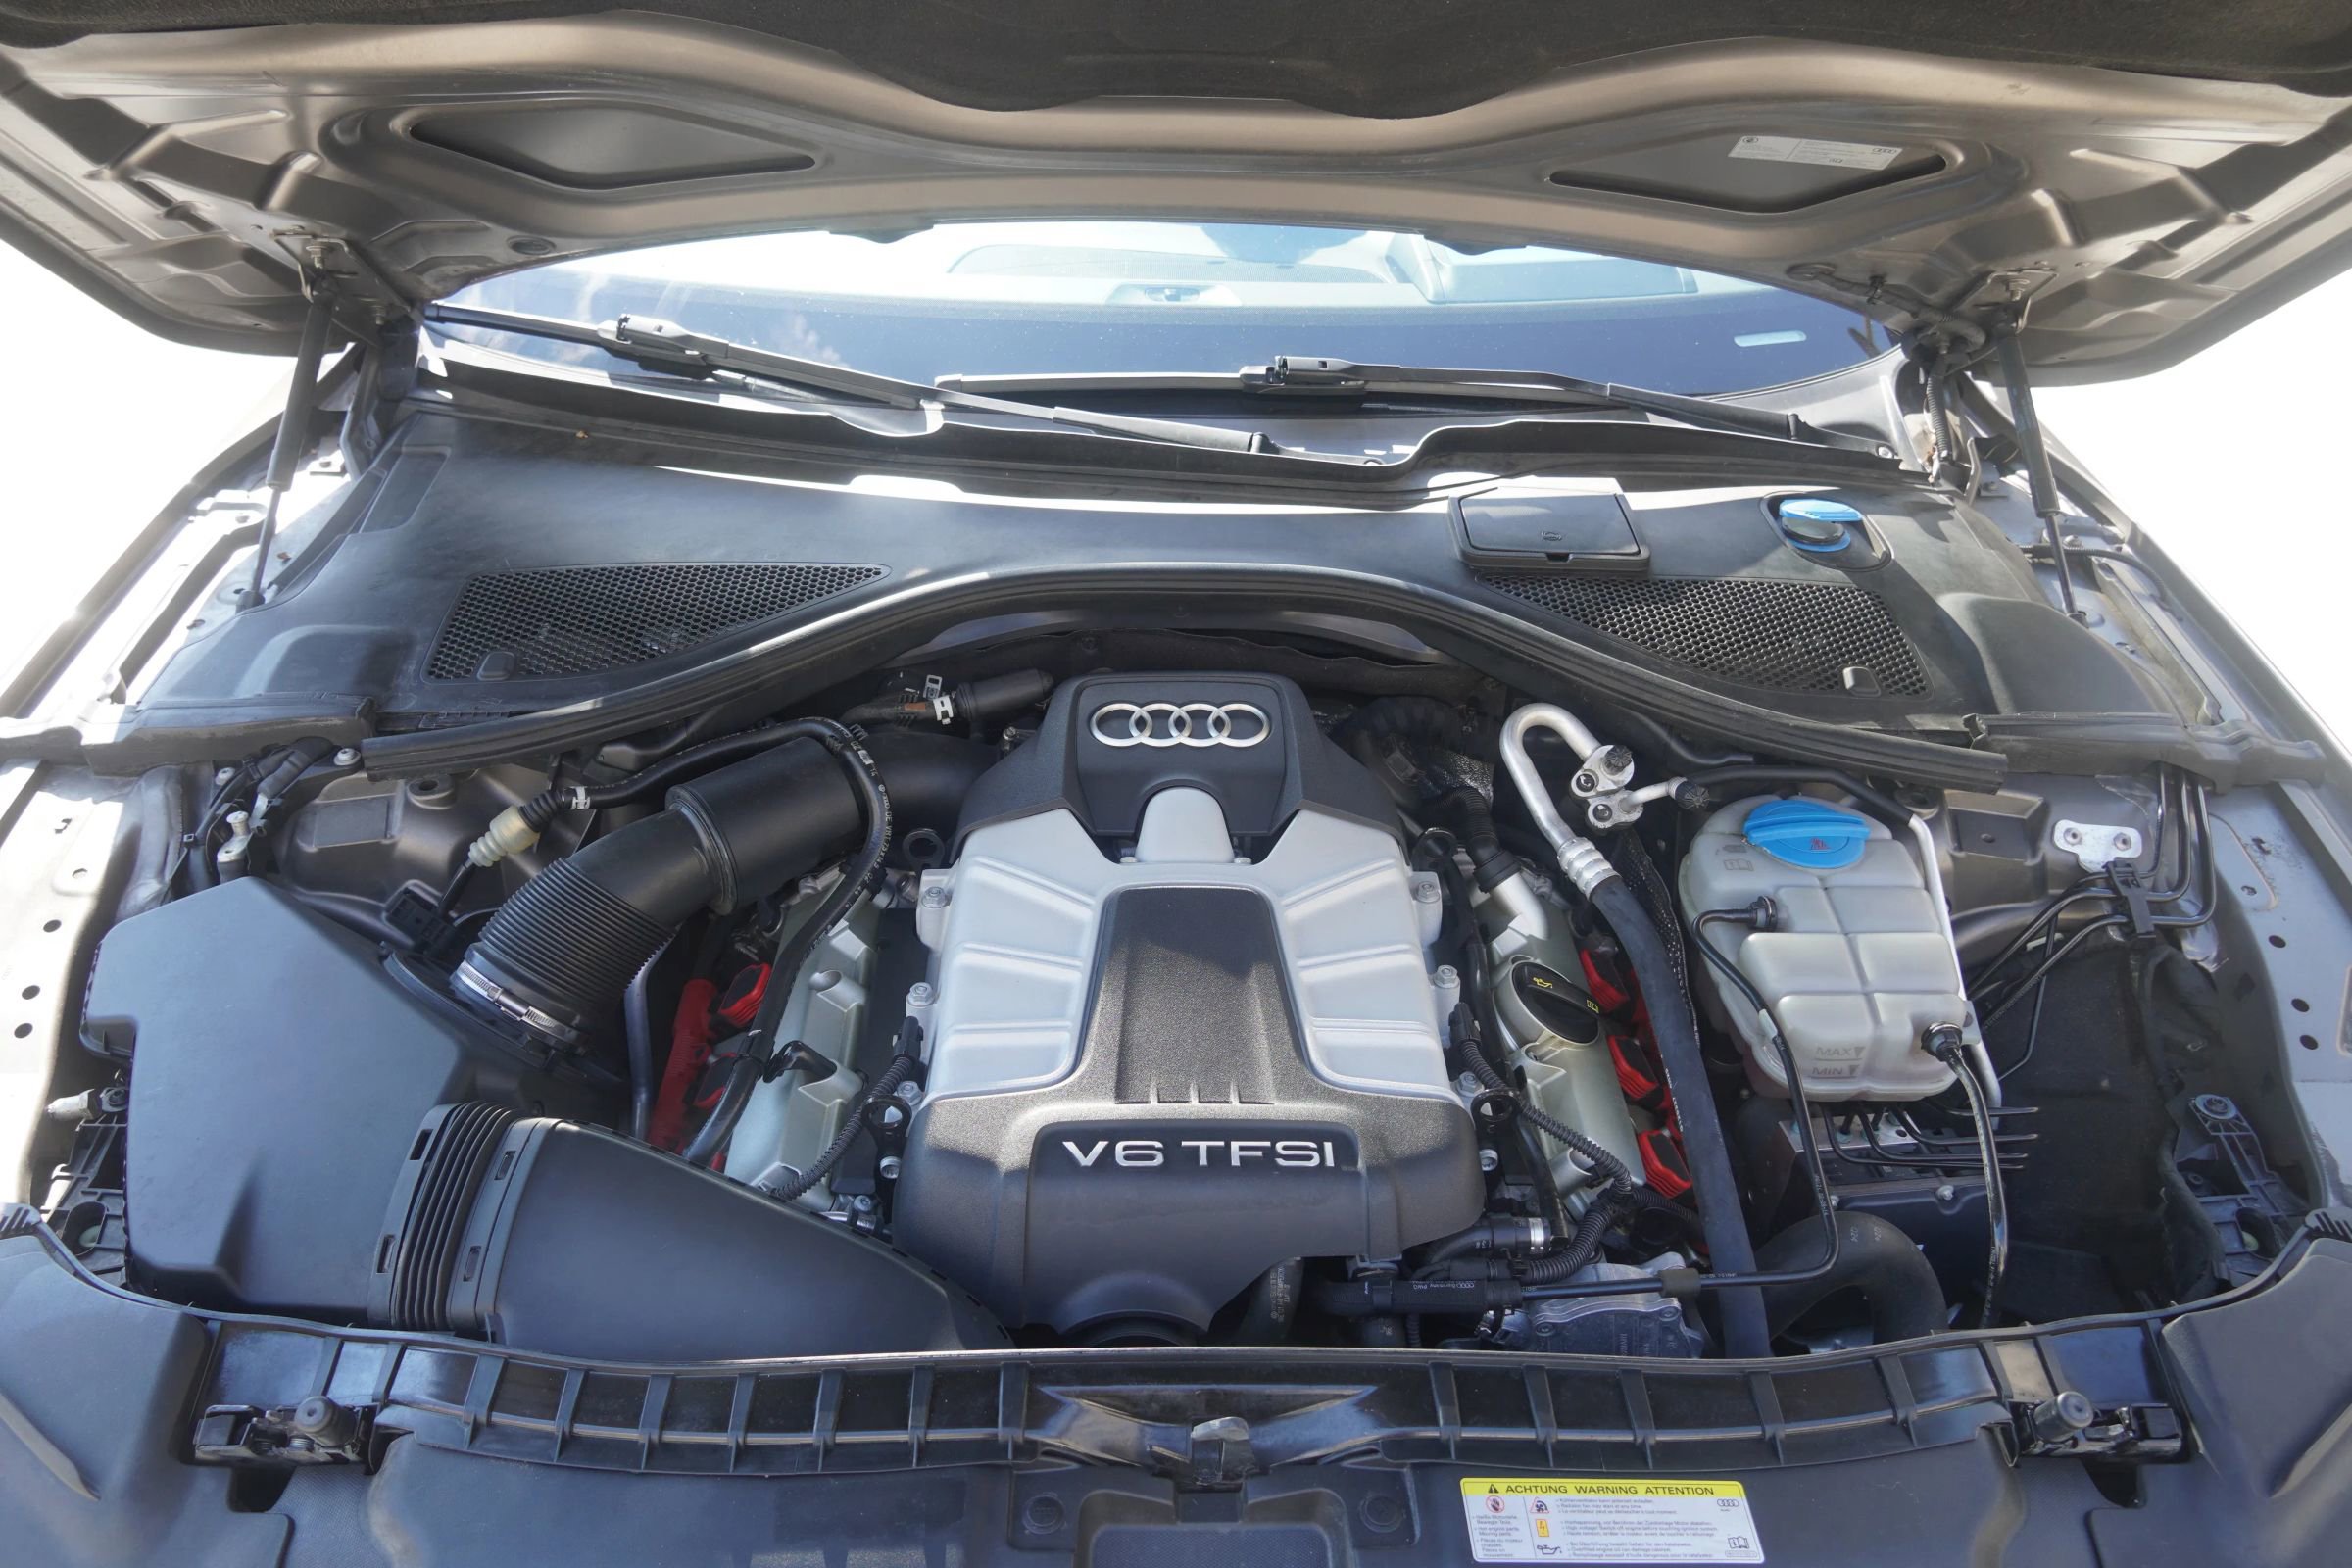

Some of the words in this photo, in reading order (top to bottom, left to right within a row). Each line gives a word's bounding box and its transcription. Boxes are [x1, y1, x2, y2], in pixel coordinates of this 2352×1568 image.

[1816, 1046, 1852, 1056] MAX
[1812, 1066, 1842, 1075] MIN
[1062, 1140, 1165, 1167] V6
[1181, 1140, 1335, 1167] TFSI
[1505, 1485, 1568, 1494] ACHTUNG
[1574, 1485, 1638, 1494] WARNING
[1644, 1486, 1714, 1495] ATTENTION
